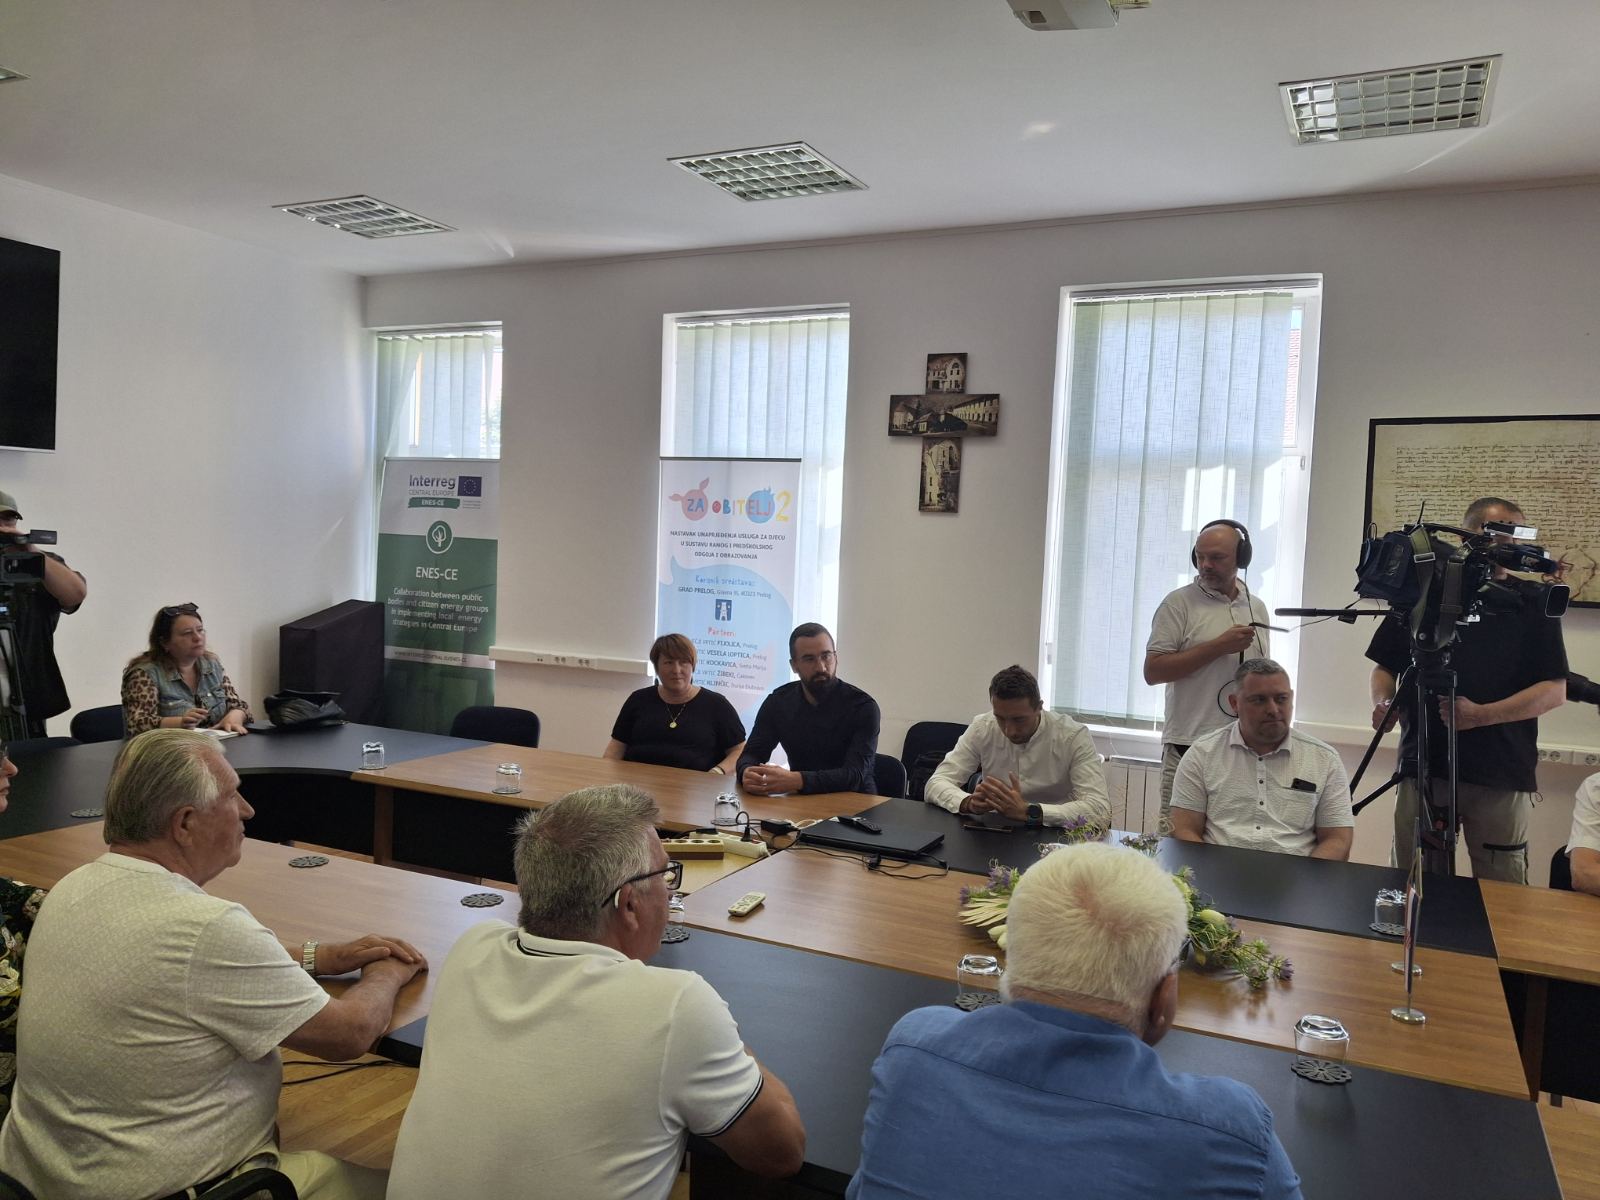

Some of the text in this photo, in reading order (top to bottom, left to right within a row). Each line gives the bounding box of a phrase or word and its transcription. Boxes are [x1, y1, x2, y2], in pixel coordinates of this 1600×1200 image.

[409, 474, 456, 490] Interreg
[687, 498, 704, 512] ZA
[776, 490, 792, 522] 2
[416, 566, 458, 580] ENES-CE
[394, 588, 482, 602] Collaboration between public
[418, 600, 438, 609] citizen
[440, 603, 464, 612] energy
[466, 604, 488, 613] groups
[458, 614, 482, 624] energy
[428, 622, 452, 631] Central
